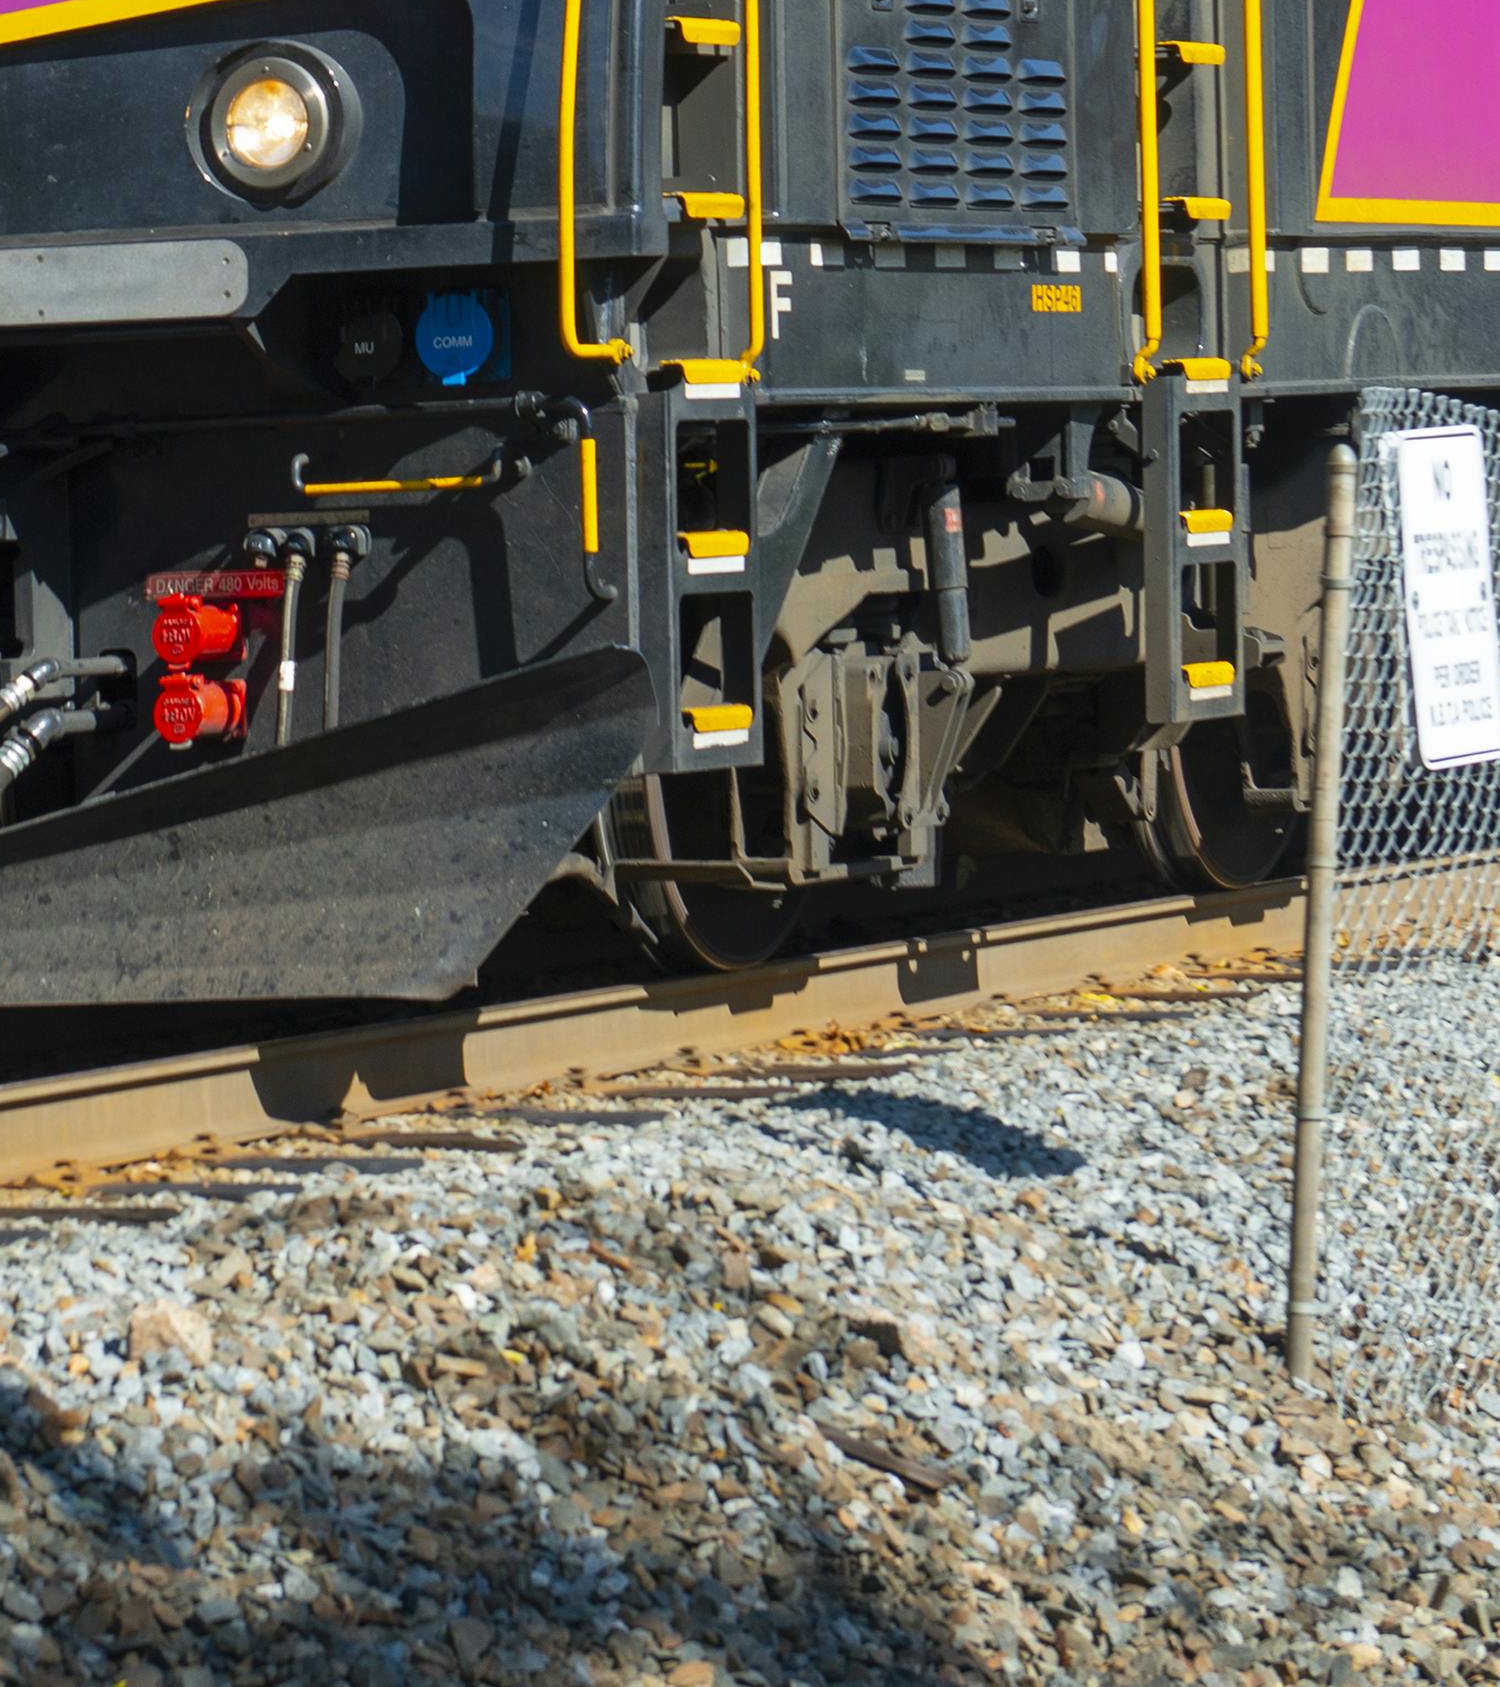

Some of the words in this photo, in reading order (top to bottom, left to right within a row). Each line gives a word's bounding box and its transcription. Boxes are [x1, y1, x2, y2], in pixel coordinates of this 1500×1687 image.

[770, 270, 793, 340] F
[1031, 283, 1082, 313] HSP46
[354, 341, 375, 355] MU
[433, 335, 473, 350] COMM
[155, 578, 214, 594] DANGER
[218, 577, 242, 592] 480
[247, 576, 280, 592] Volts
